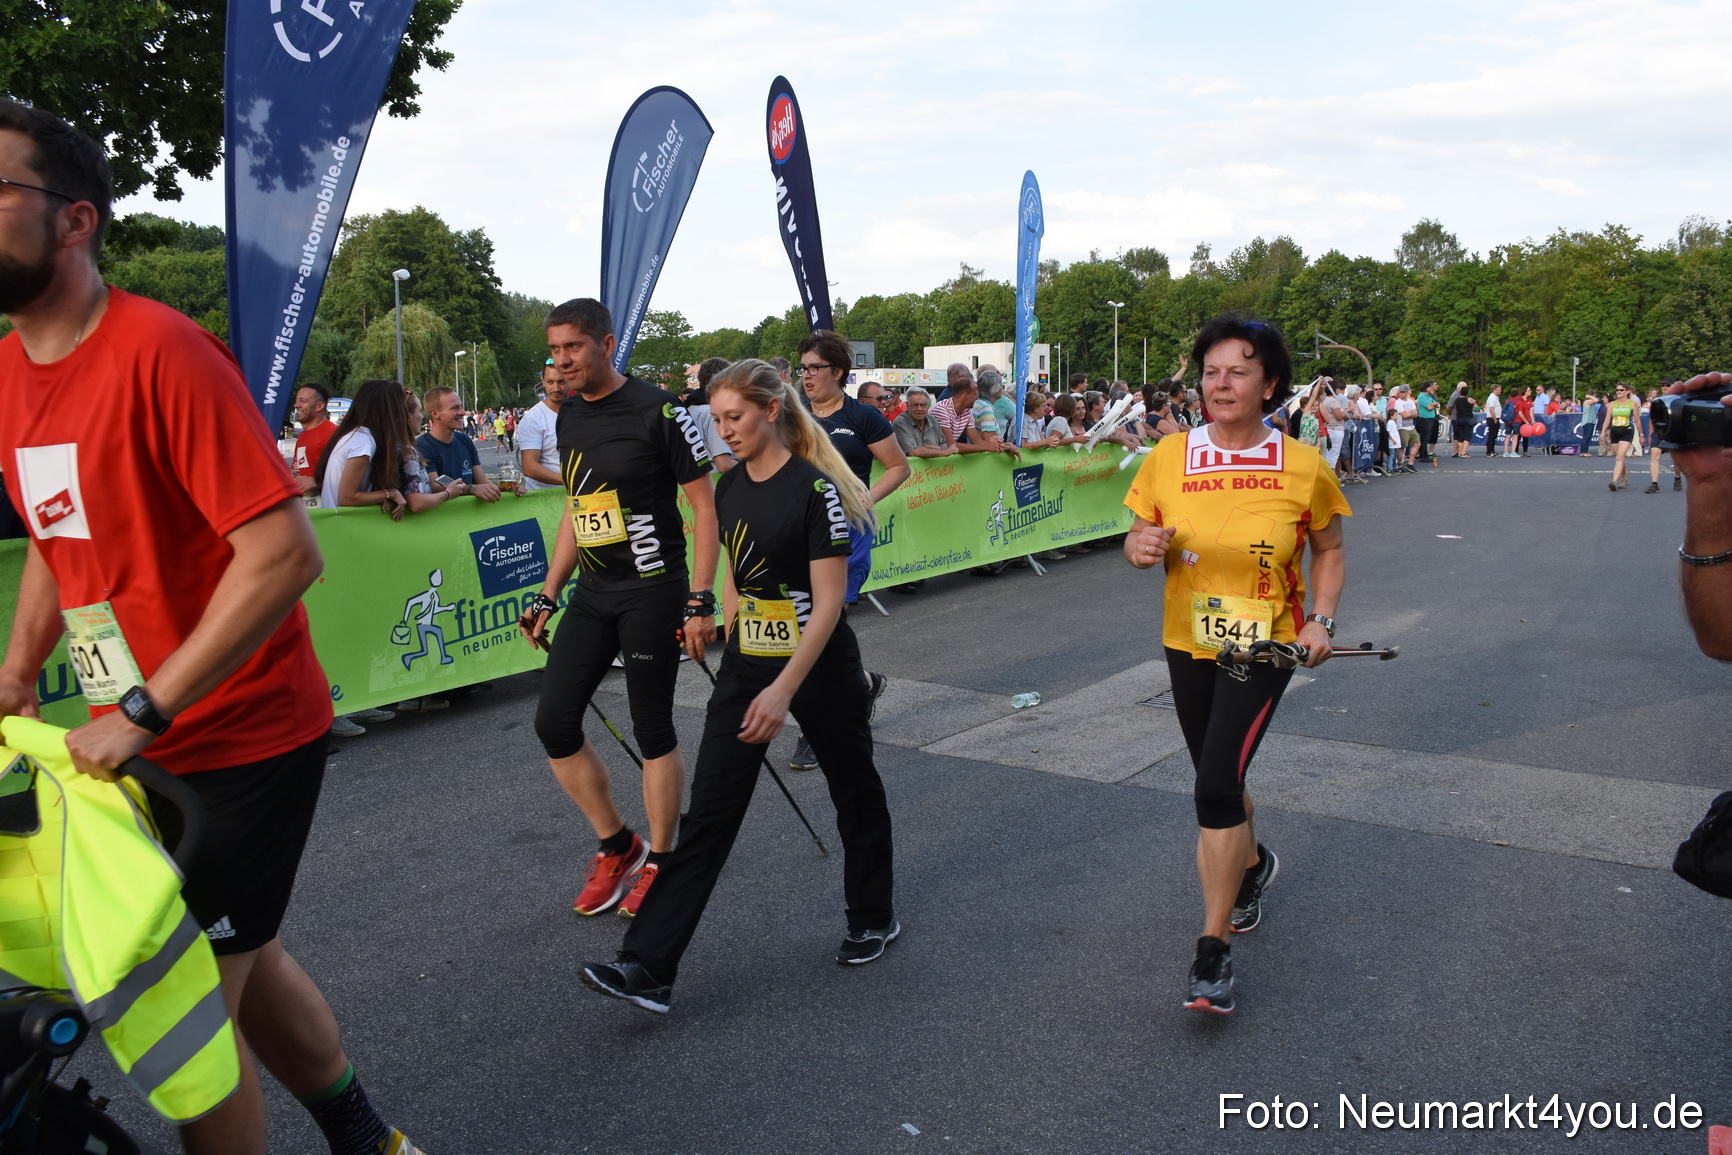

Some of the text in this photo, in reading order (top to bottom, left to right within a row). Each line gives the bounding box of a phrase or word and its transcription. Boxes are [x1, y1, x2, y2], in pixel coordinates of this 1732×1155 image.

[642, 119, 678, 199] Fischer
[657, 134, 684, 198] AUTOMOBILE
[263, 136, 351, 405] www.fischer-automobile.de
[614, 254, 660, 372] .fischer-automobile.de
[894, 463, 955, 491] sunde Firmen
[1182, 474, 1284, 493] MAX BÖGL
[905, 475, 967, 511] laufen länger!
[574, 511, 612, 533] 1751
[1008, 489, 1064, 532] firmenlauf
[1010, 525, 1036, 540] neumarkt
[489, 541, 534, 561] Fischer
[496, 552, 533, 567] AUTOMOBILE
[871, 546, 972, 581] www.firmenlauf-oberpfalz.de
[463, 628, 523, 656] neumar
[744, 619, 790, 641] 1748
[1201, 615, 1259, 642] 1544
[206, 929, 236, 940] didas
